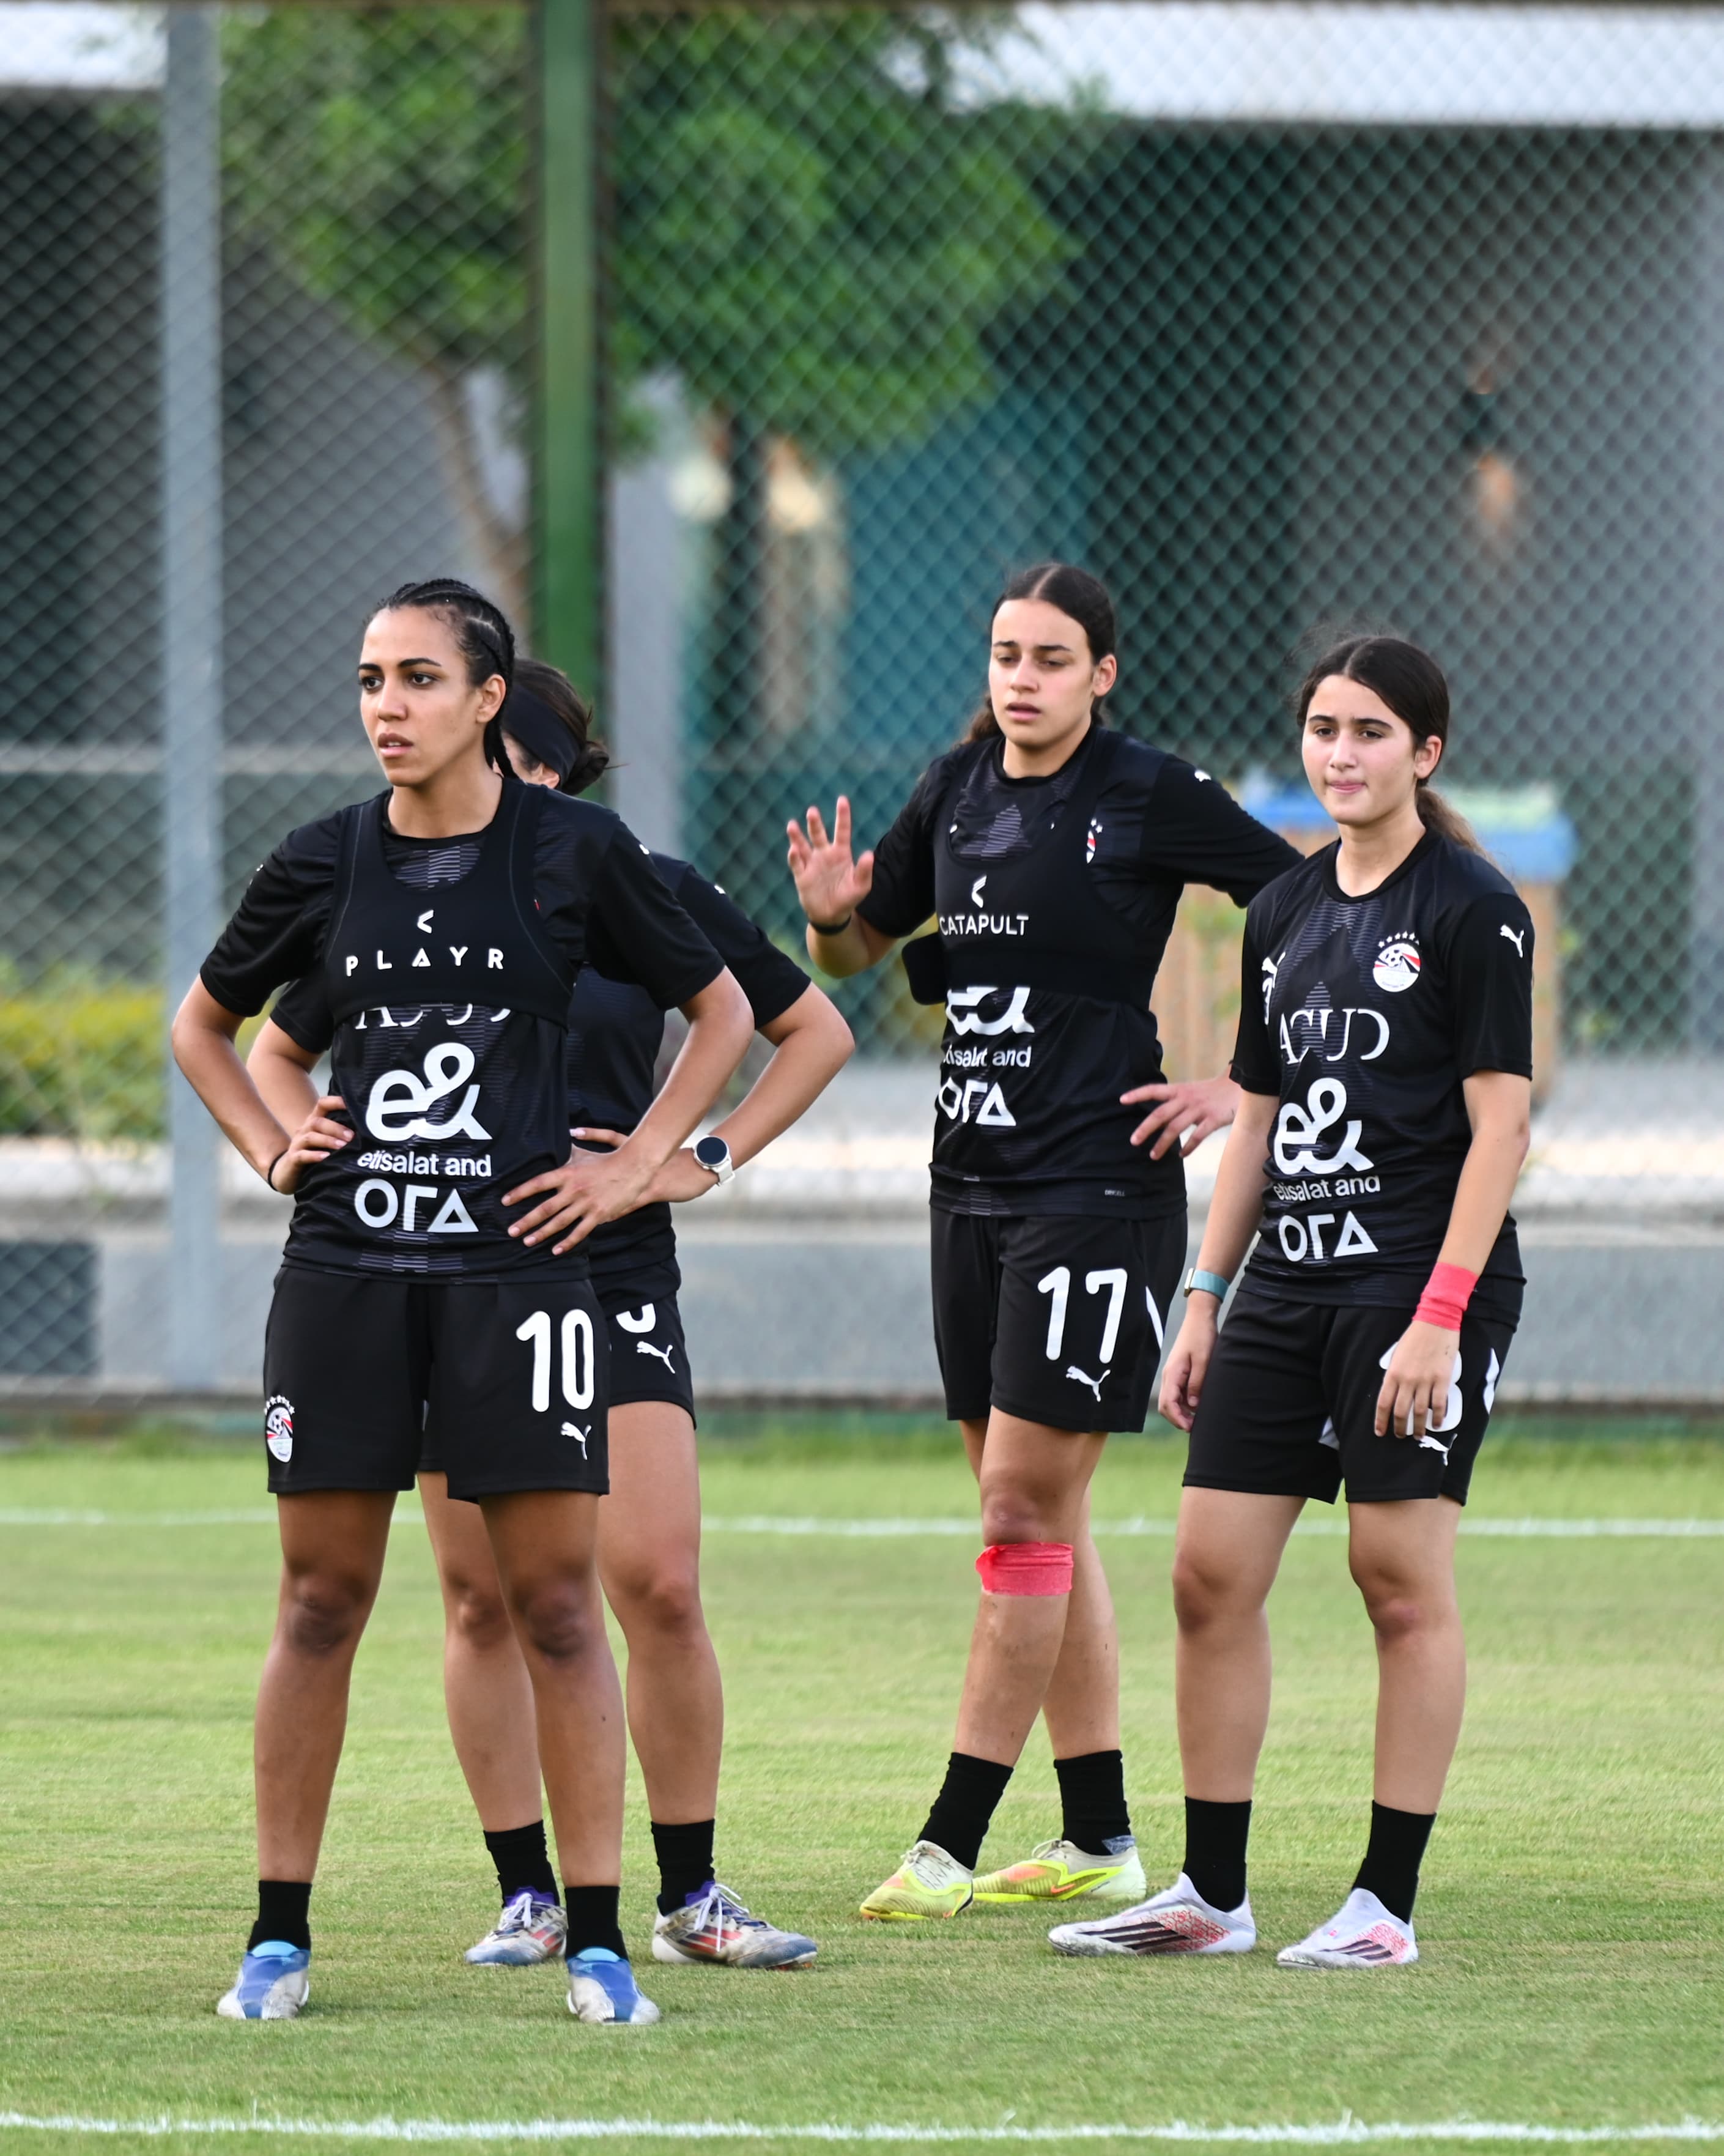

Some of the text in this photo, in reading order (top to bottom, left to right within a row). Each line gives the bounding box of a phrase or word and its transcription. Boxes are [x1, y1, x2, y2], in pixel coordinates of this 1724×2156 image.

[939, 914, 1030, 936] CATAPULT
[345, 946, 505, 977] PLAYR
[991, 1046, 1032, 1068] and
[357, 1150, 492, 1177] etisalat and
[1037, 1265, 1128, 1364] 17
[515, 1308, 595, 1412] 10
